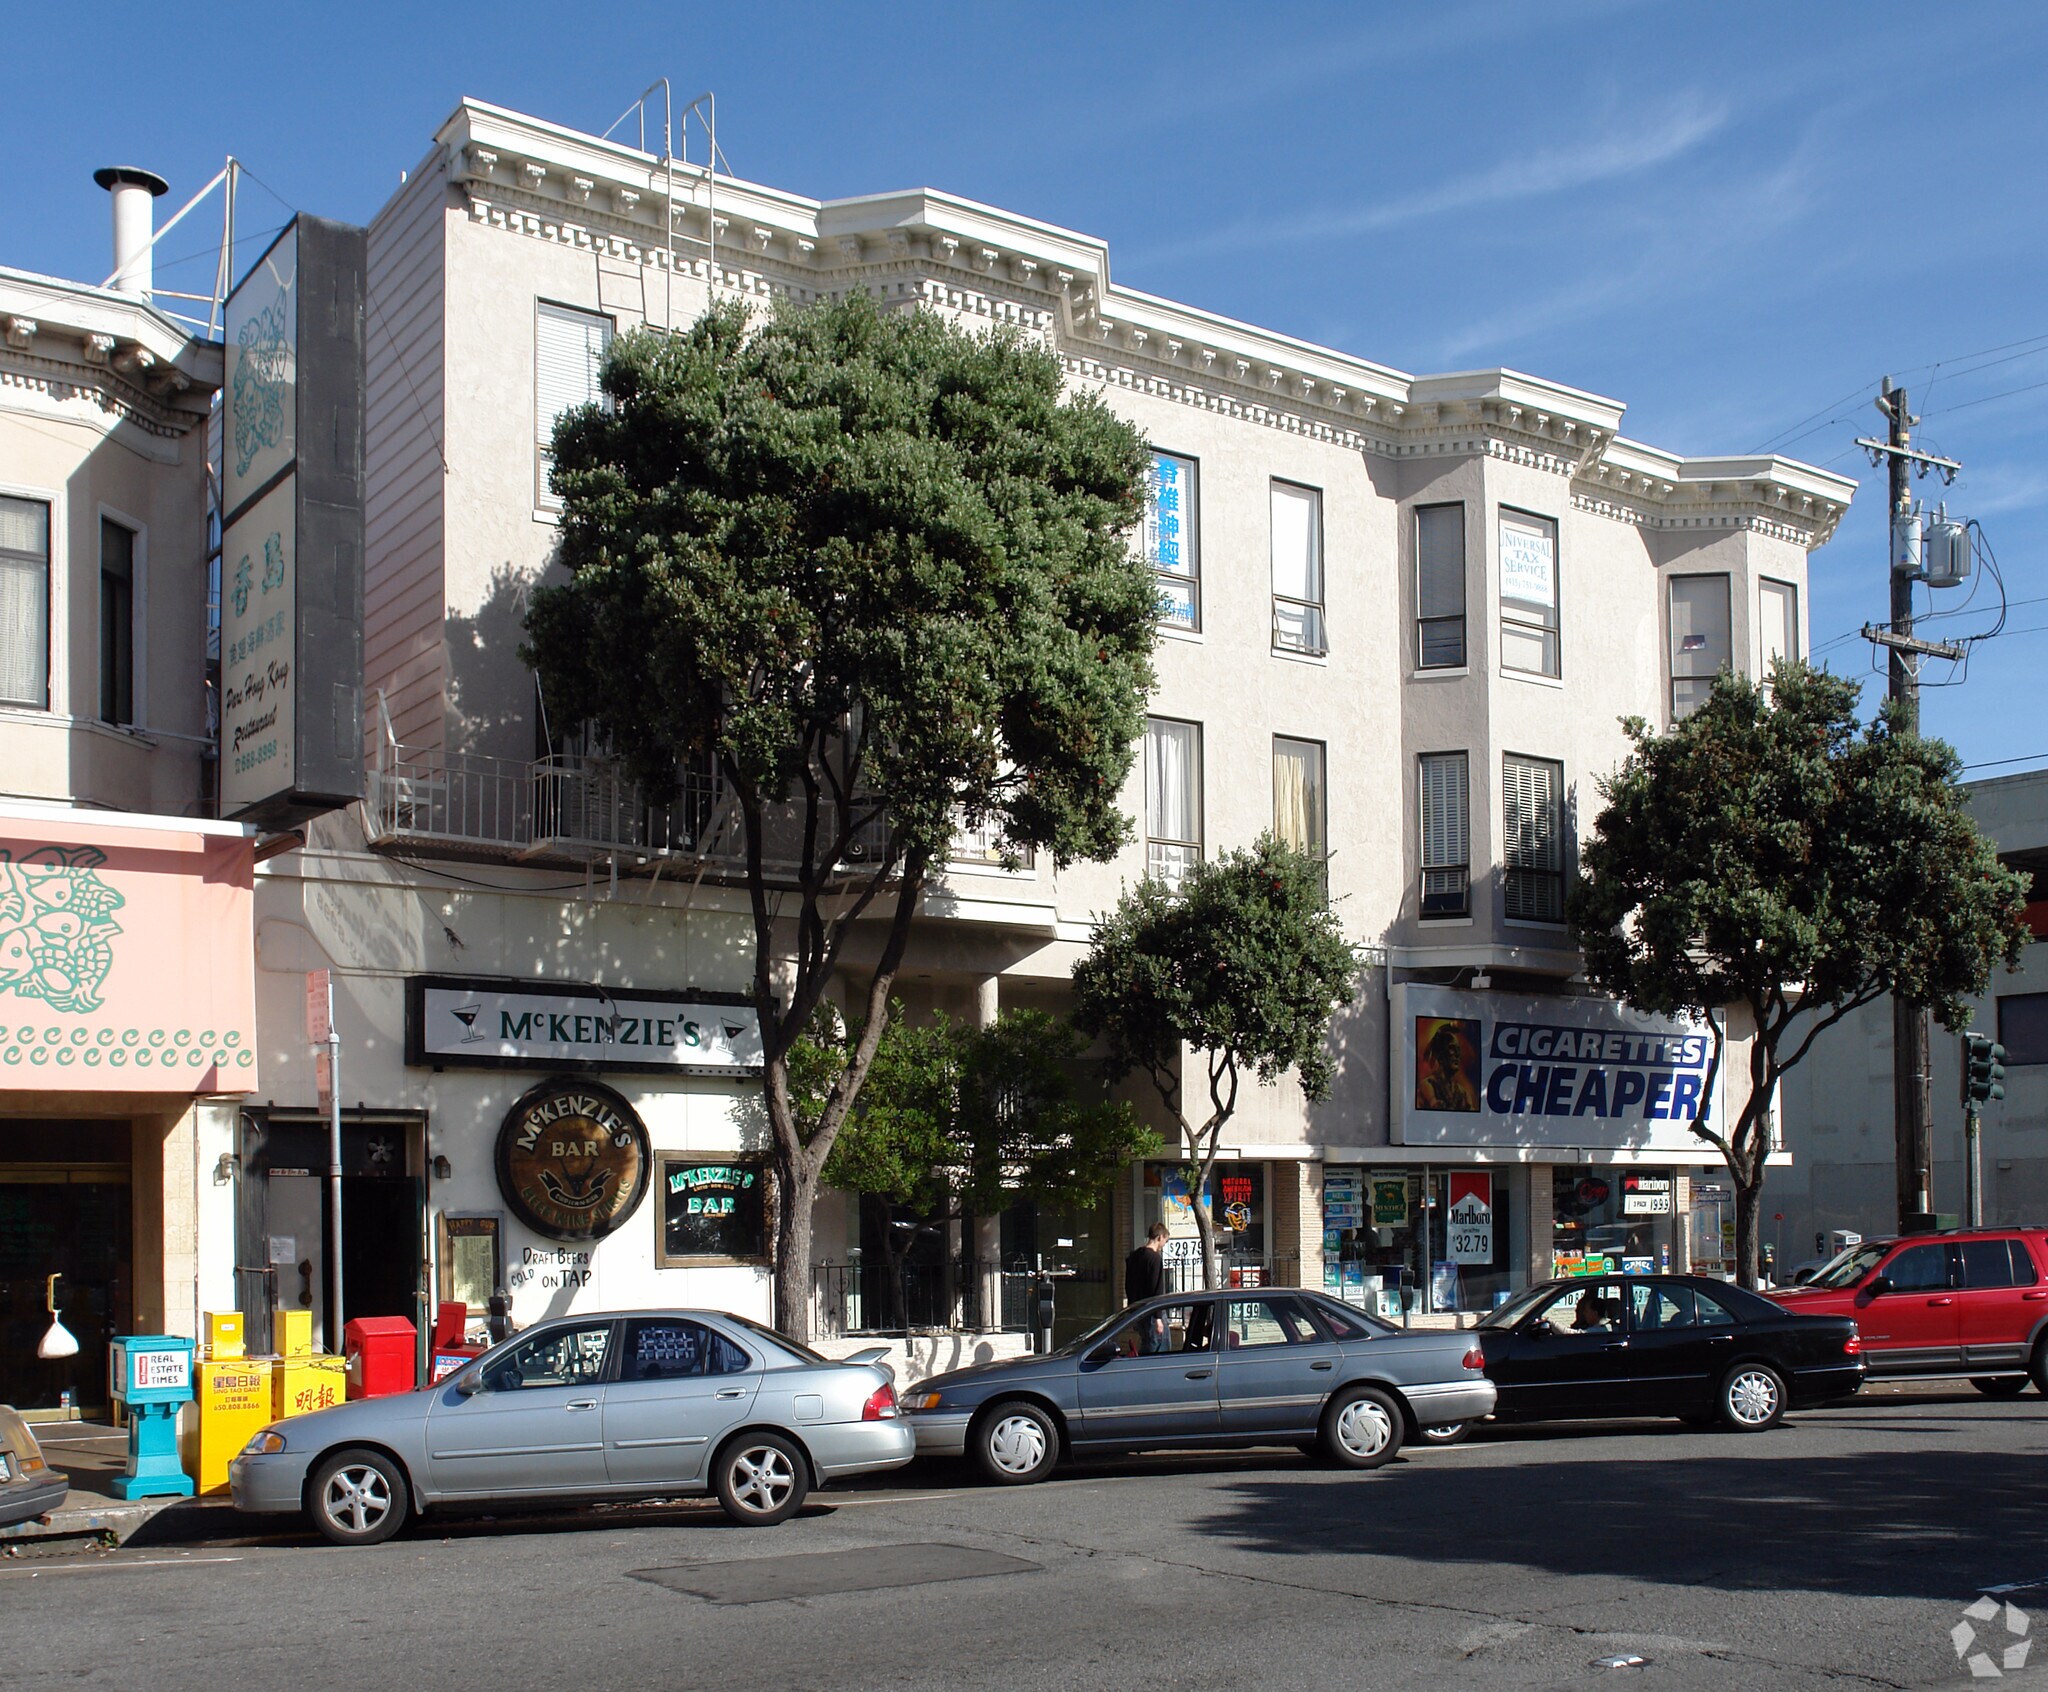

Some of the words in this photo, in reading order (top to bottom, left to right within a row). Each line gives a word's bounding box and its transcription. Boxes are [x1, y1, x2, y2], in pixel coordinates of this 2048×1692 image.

[1513, 550, 1540, 564] TAX
[1504, 556, 1547, 582] SERVICE
[1497, 1027, 1702, 1064] CIGARETTES
[552, 1141, 600, 1157] BAR
[1638, 1176, 1670, 1191] Marlboro
[687, 1197, 736, 1214] BAR
[1223, 1192, 1252, 1204] SPIRIT
[1450, 1204, 1491, 1225] Marlboro
[1453, 1234, 1488, 1253] $32.79
[523, 1246, 554, 1265] DRAFT
[557, 1247, 589, 1265] BEERS
[1624, 1260, 1652, 1271] CAMEL
[511, 1268, 535, 1286] COLD
[542, 1275, 558, 1288] ON
[559, 1269, 592, 1288] TAP
[151, 1354, 175, 1364] REAL
[150, 1364, 184, 1374] ESTATE
[151, 1375, 179, 1385] TIMES
[213, 1375, 260, 1388] 星島日報
[294, 1383, 336, 1411] 明報
